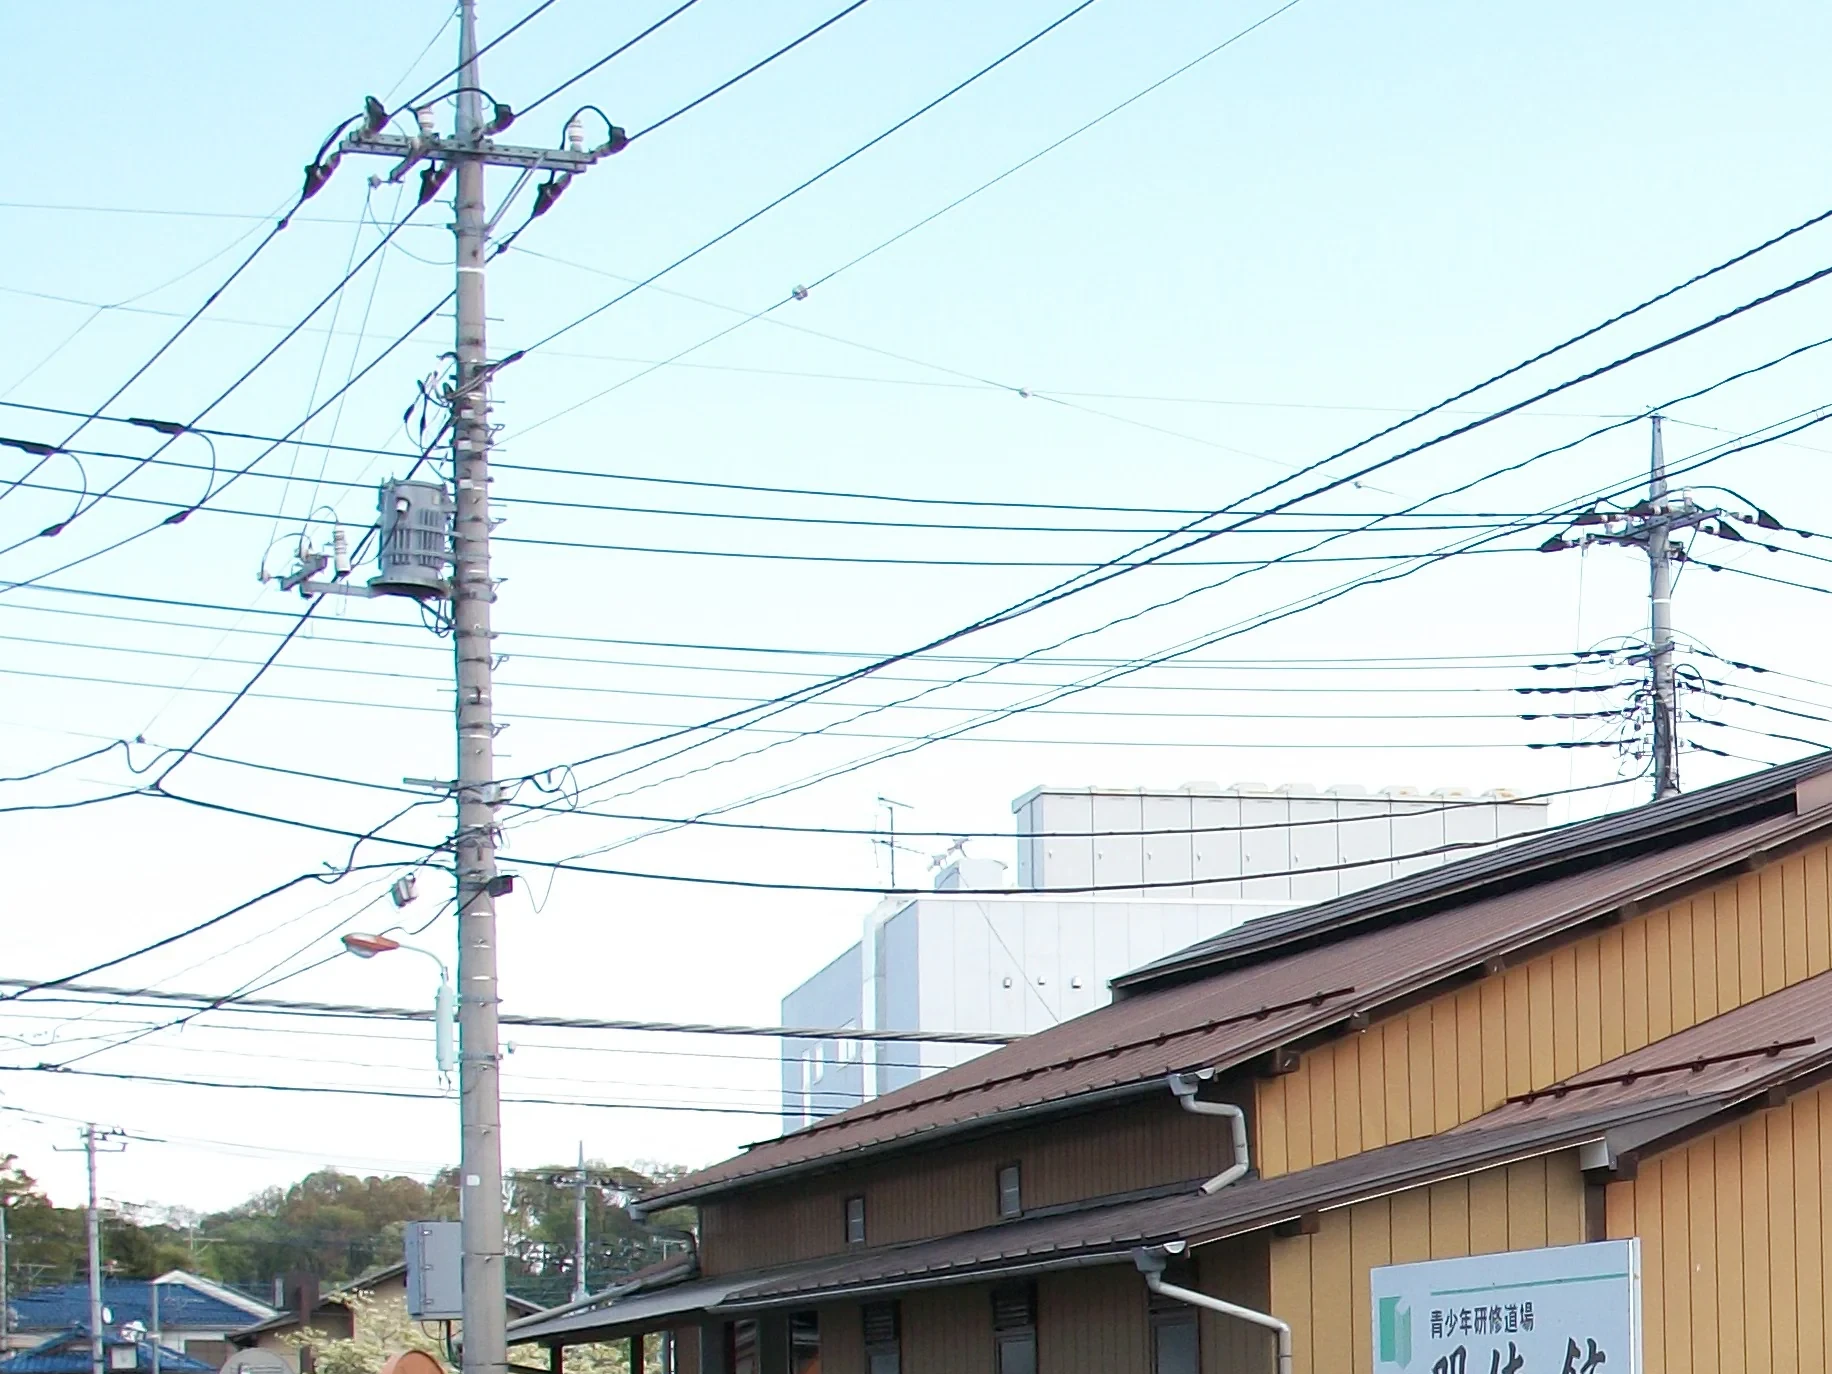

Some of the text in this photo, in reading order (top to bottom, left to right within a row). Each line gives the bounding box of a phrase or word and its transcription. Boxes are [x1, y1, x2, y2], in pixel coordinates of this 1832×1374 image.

[1430, 1302, 1534, 1338] 青少年研修道場
